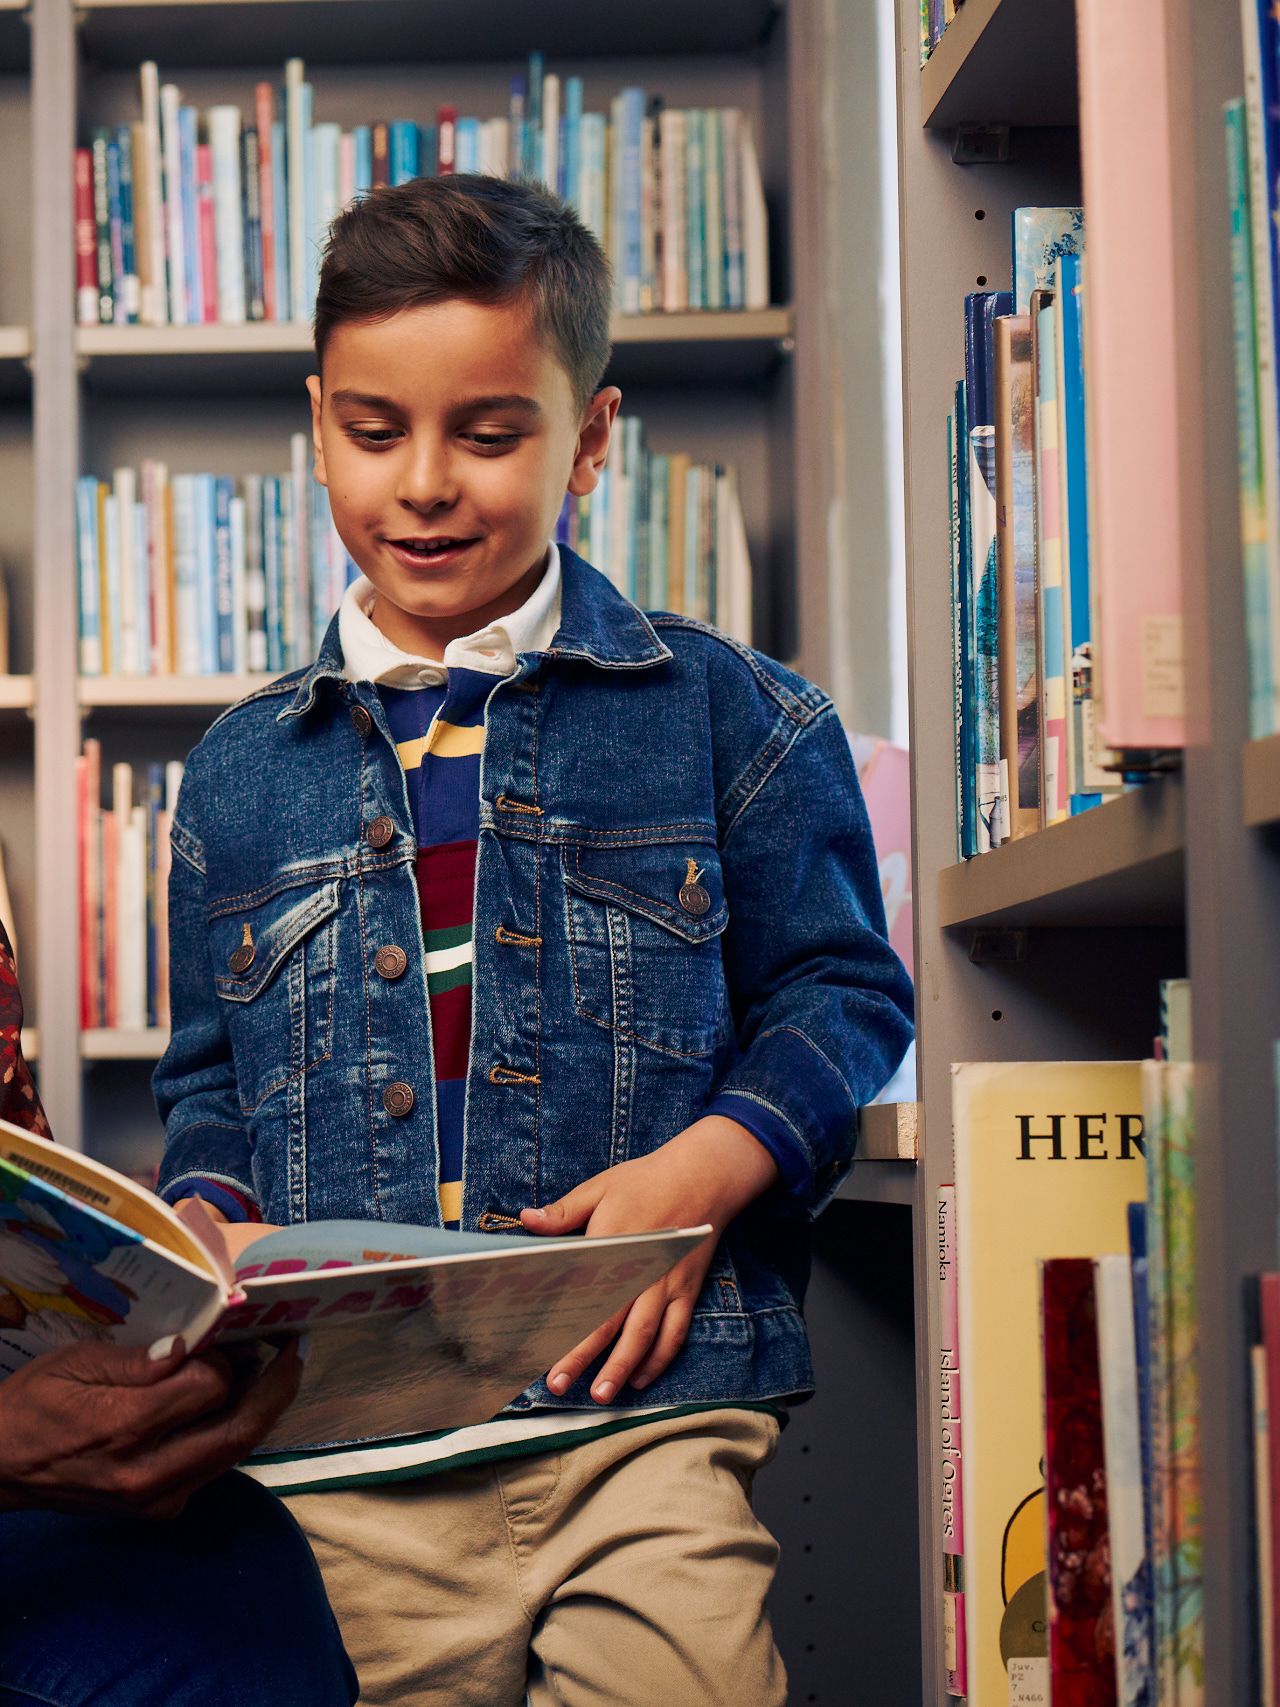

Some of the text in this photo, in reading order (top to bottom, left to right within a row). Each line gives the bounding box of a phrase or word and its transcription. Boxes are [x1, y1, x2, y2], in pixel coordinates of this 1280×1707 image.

[938, 1200, 951, 1281] Namioka
[940, 1348, 962, 1538] Island of Ogres
